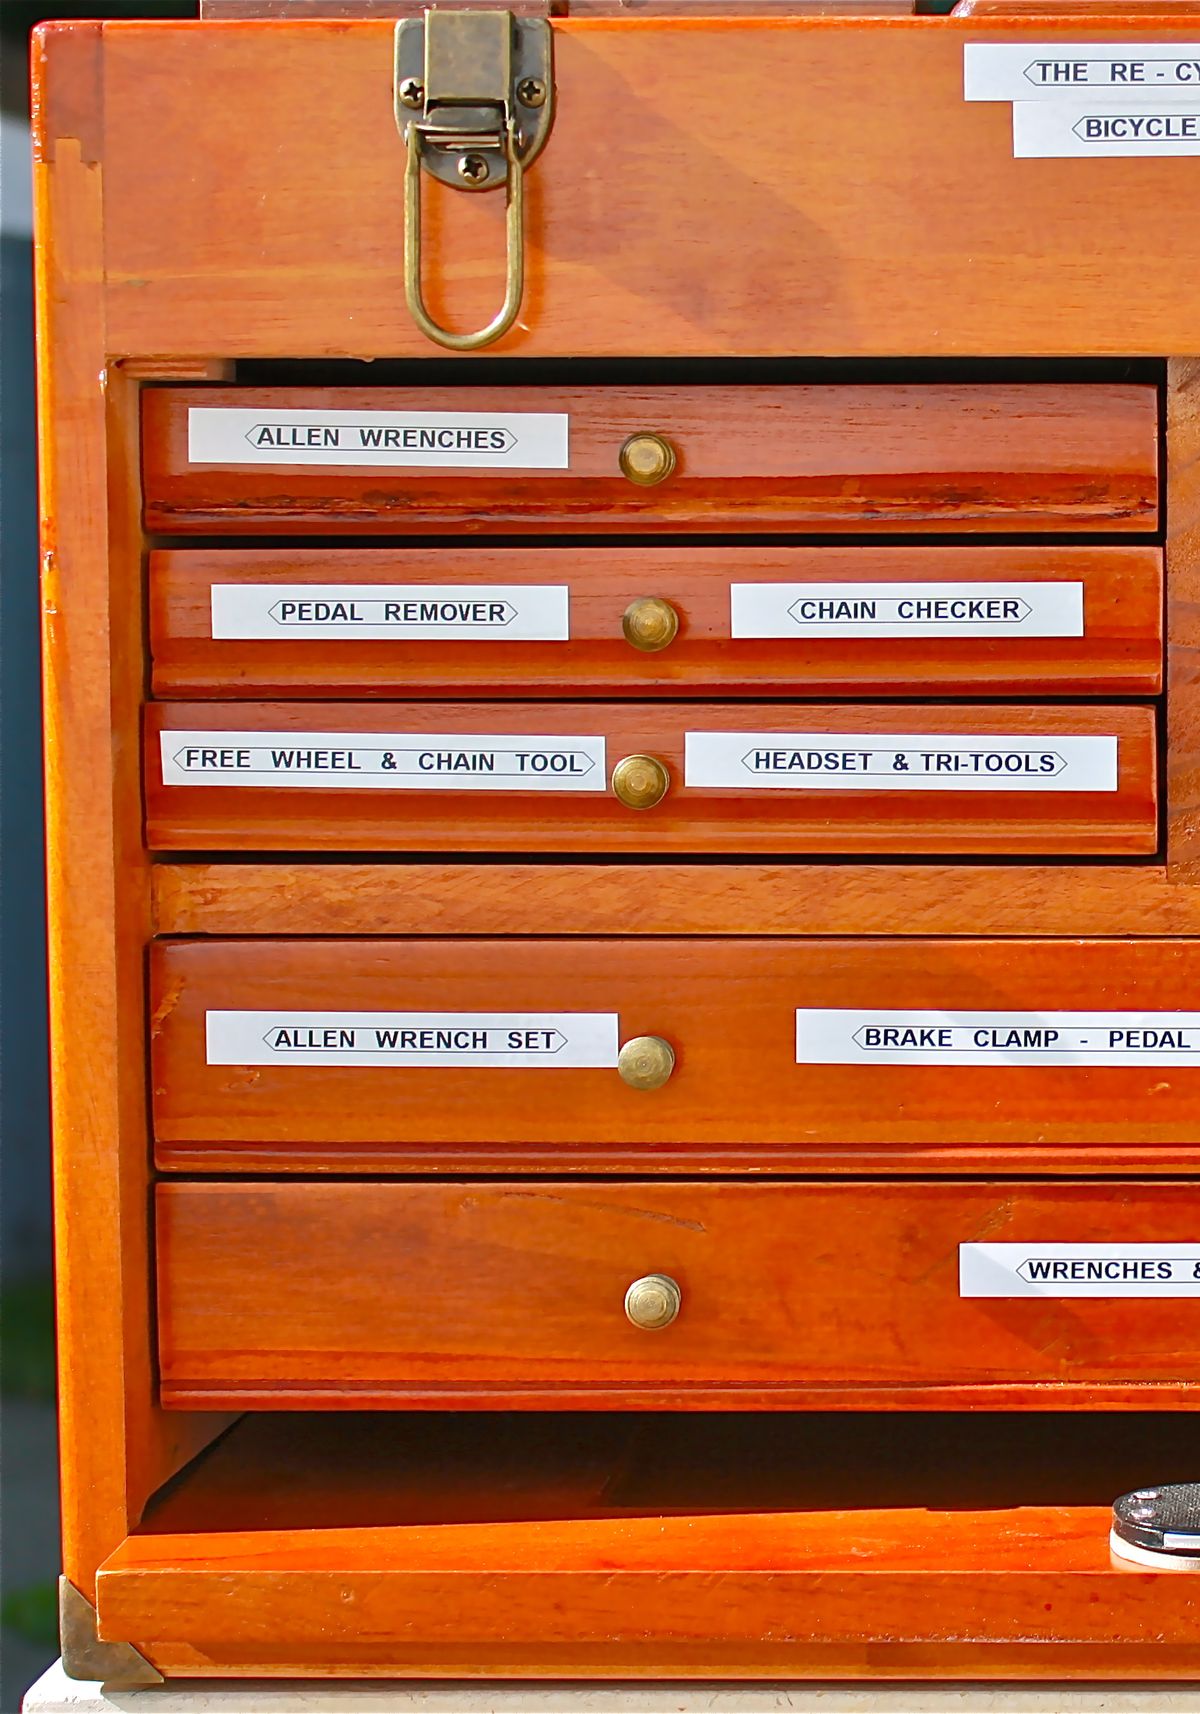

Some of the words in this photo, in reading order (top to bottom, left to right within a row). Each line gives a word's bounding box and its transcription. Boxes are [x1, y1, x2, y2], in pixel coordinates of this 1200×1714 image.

[1036, 63, 1088, 82] THE
[1111, 63, 1145, 81] RE
[1086, 118, 1197, 137] BICYCLE
[257, 427, 339, 446] ALLEN
[359, 429, 505, 449] WRENCHES
[281, 603, 364, 621] PEDAL
[385, 603, 505, 622] REMOVER
[800, 601, 876, 620] CHAIN
[897, 600, 1019, 619] CHECKER
[186, 749, 251, 768] FREE
[270, 750, 362, 770] WHEEL
[381, 752, 398, 770] &
[418, 752, 494, 771] CHAIN
[515, 753, 583, 772] TOOL
[755, 751, 873, 771] HEADSET
[892, 753, 910, 771] &
[920, 753, 1055, 773] TRI-TOOLS
[274, 1029, 355, 1048] ALLEN
[375, 1030, 487, 1049] WRENCH
[507, 1031, 556, 1049] SET
[865, 1028, 953, 1047] BRAKE
[973, 1029, 1059, 1048] CLAMP
[1109, 1030, 1191, 1049] PEDAL
[1028, 1261, 1173, 1280] WRENCHES
